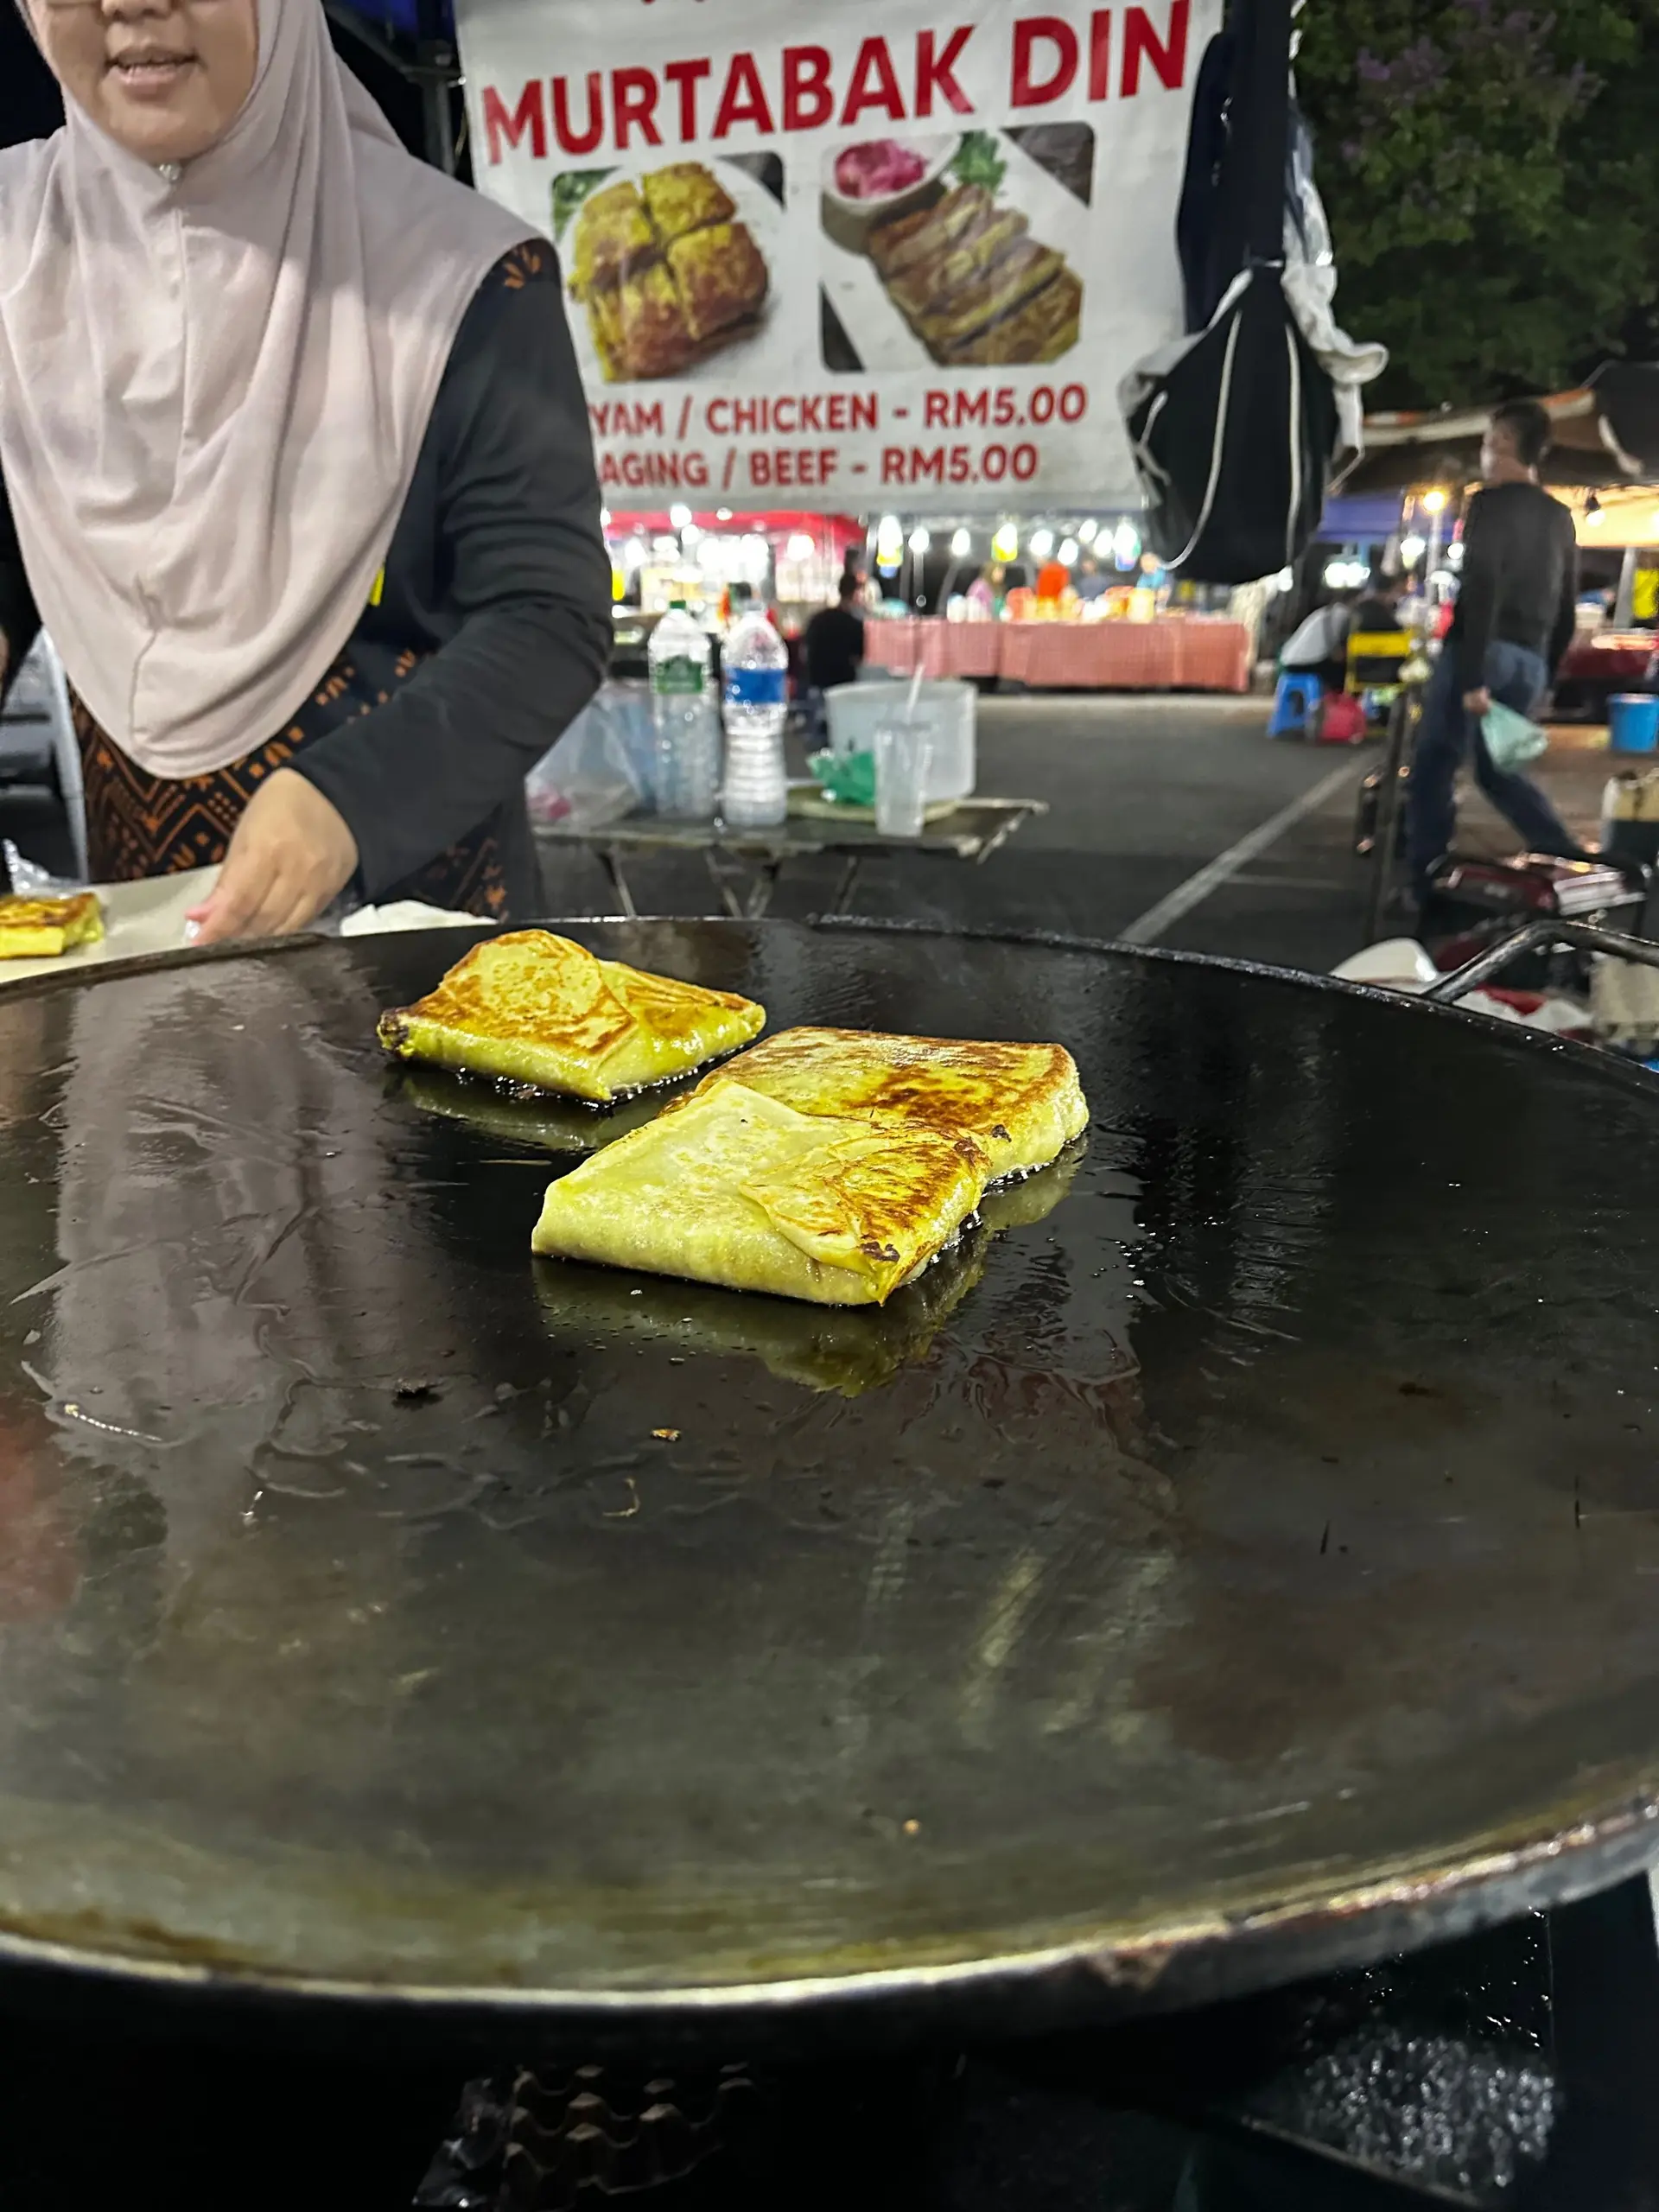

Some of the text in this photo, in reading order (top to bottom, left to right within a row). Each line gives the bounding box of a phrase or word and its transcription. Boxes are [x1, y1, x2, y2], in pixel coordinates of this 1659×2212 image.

[482, 0, 1192, 164] MURTABAK DIN
[588, 384, 1087, 441] YAM / CHICKEN - RM5.00
[598, 444, 1039, 492] AGING / BEEF - RM5.00
